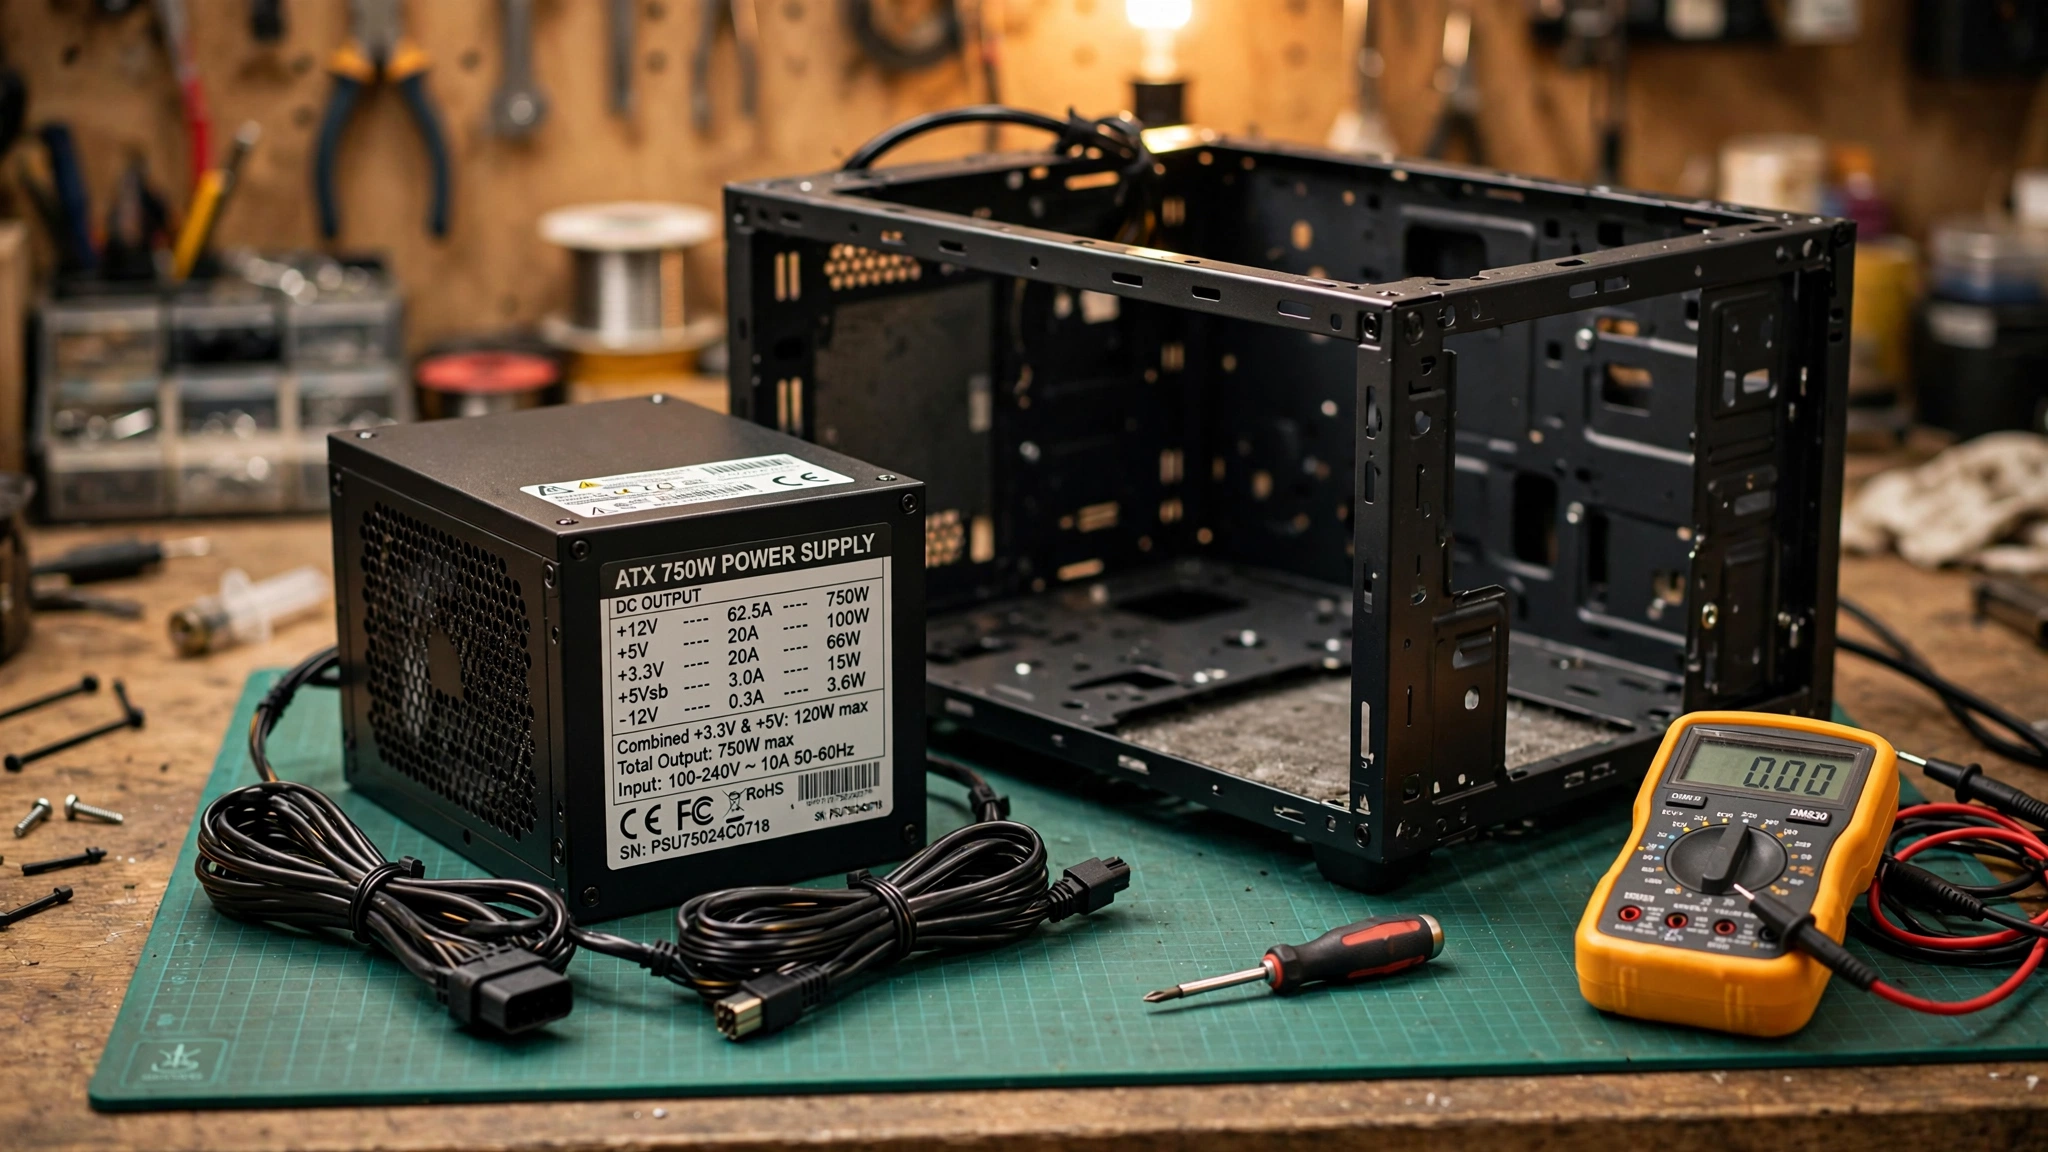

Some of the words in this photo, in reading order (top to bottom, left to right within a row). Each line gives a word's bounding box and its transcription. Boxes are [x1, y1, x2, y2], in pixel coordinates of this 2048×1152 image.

[615, 565, 656, 590] ATX
[662, 556, 716, 582] 750W
[722, 544, 796, 573] POWER
[800, 533, 876, 562] SUPPLY
[616, 599, 637, 614] DC
[642, 588, 702, 610] OUTPUT
[617, 618, 658, 638] +12V
[728, 602, 772, 622] 62.5A
[826, 586, 870, 606] 750W
[617, 642, 649, 660] +5V
[728, 625, 759, 644] 20A
[827, 608, 870, 628] 100W
[618, 661, 664, 681] +3.3V
[728, 647, 759, 666] 20A
[826, 630, 861, 650] 66W
[618, 684, 668, 704] +5Vsb
[728, 668, 764, 688] 3.0A
[828, 652, 861, 670] 15W
[619, 706, 658, 726] -12V
[729, 690, 764, 709] 0.3A
[827, 672, 866, 692] 3.6W
[617, 729, 690, 754] Combined
[694, 720, 736, 740] +3.3V
[740, 718, 751, 733] &
[756, 712, 789, 730] +5V:
[794, 704, 834, 724] 120W
[838, 702, 868, 716] max
[618, 752, 653, 776] Total
[658, 748, 712, 773] Output:
[718, 738, 760, 758] 750W
[764, 734, 794, 750] max
[618, 778, 662, 798] Input:
[668, 762, 740, 788] 100-240V
[762, 754, 790, 770] 10A
[794, 743, 854, 766] 50-60Hz
[1743, 756, 1837, 796] 0.00
[746, 782, 784, 800] RoHS
[620, 843, 646, 860] SN:
[652, 819, 770, 854] PSU75024C0718
